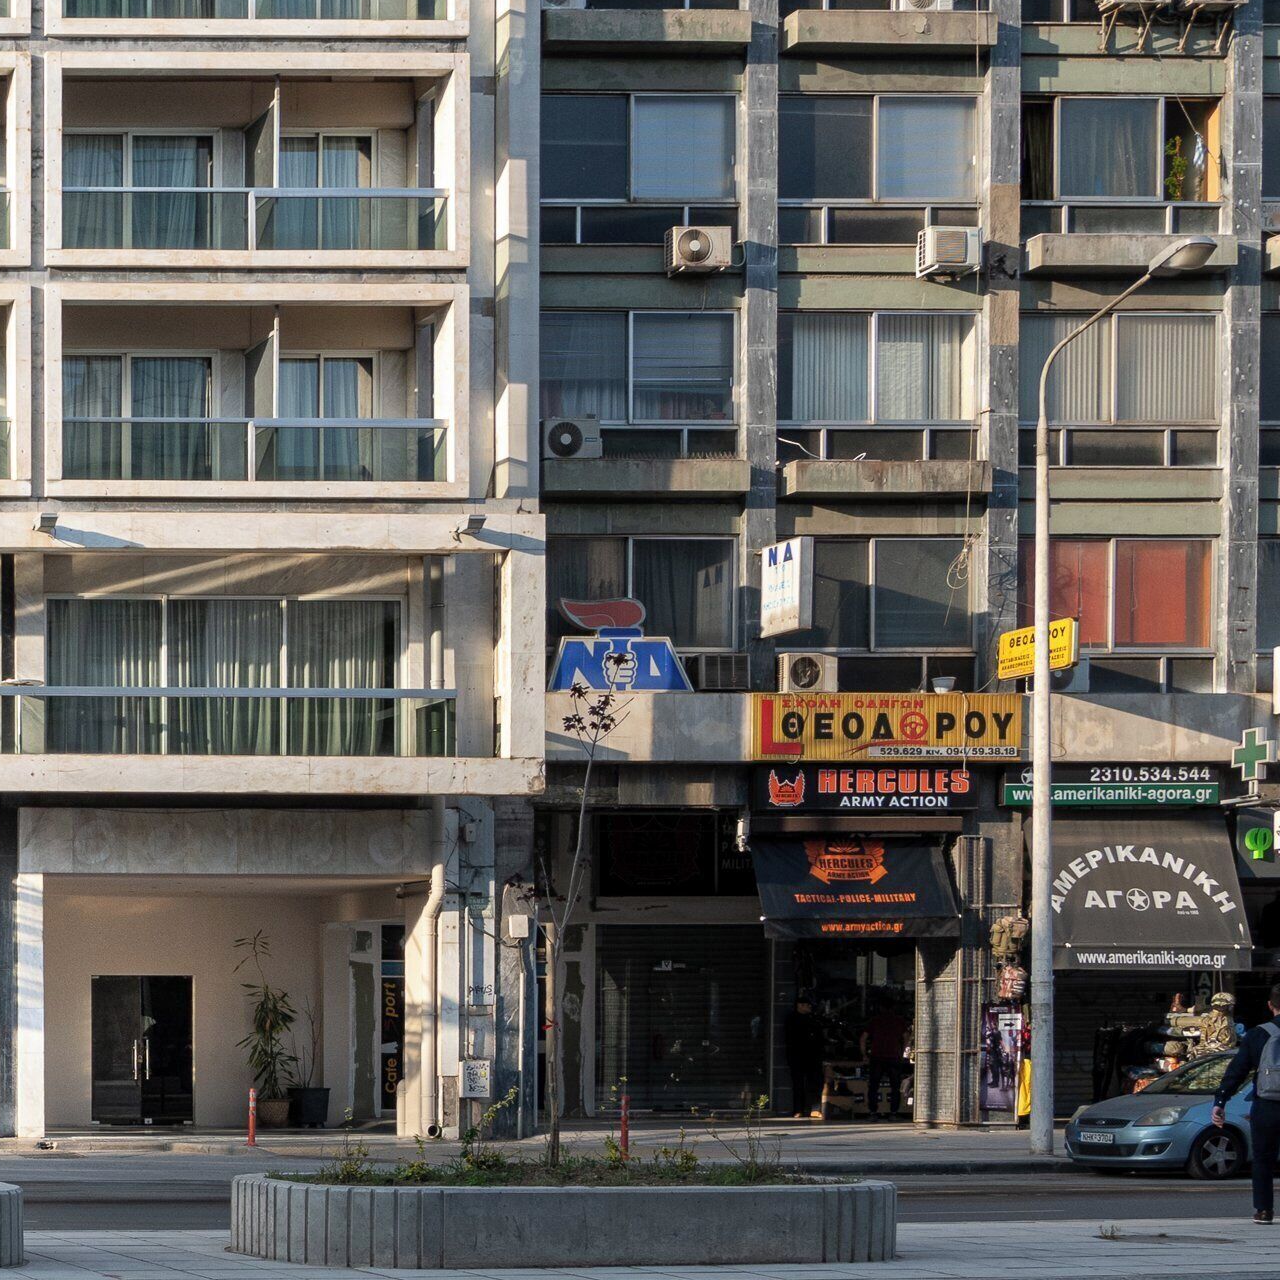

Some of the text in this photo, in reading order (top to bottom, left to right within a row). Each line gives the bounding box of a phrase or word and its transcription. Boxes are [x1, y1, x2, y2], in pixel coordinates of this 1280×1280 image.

[1009, 626, 1066, 648] ΘΕΟΔΟΥ
[782, 698, 924, 709] ΣΧΟΛΗ ΟΔΗΓΩΝ
[880, 747, 923, 757] 529.629
[817, 768, 970, 794] HERCULES
[1090, 766, 1211, 782] 2310.534.544
[840, 795, 949, 808] ARMY ACTION
[1012, 785, 1212, 804] ww.amerikaniki-agora.gr
[819, 857, 875, 870] HERCULES
[827, 870, 871, 880] ARMY ACTION
[1050, 845, 1237, 914] ΑΜΕΡΙΚΑΝΙΚΗ
[821, 920, 904, 934] www.armyaction.gr
[1076, 950, 1227, 968] www.amerikaniki-agora.gr
